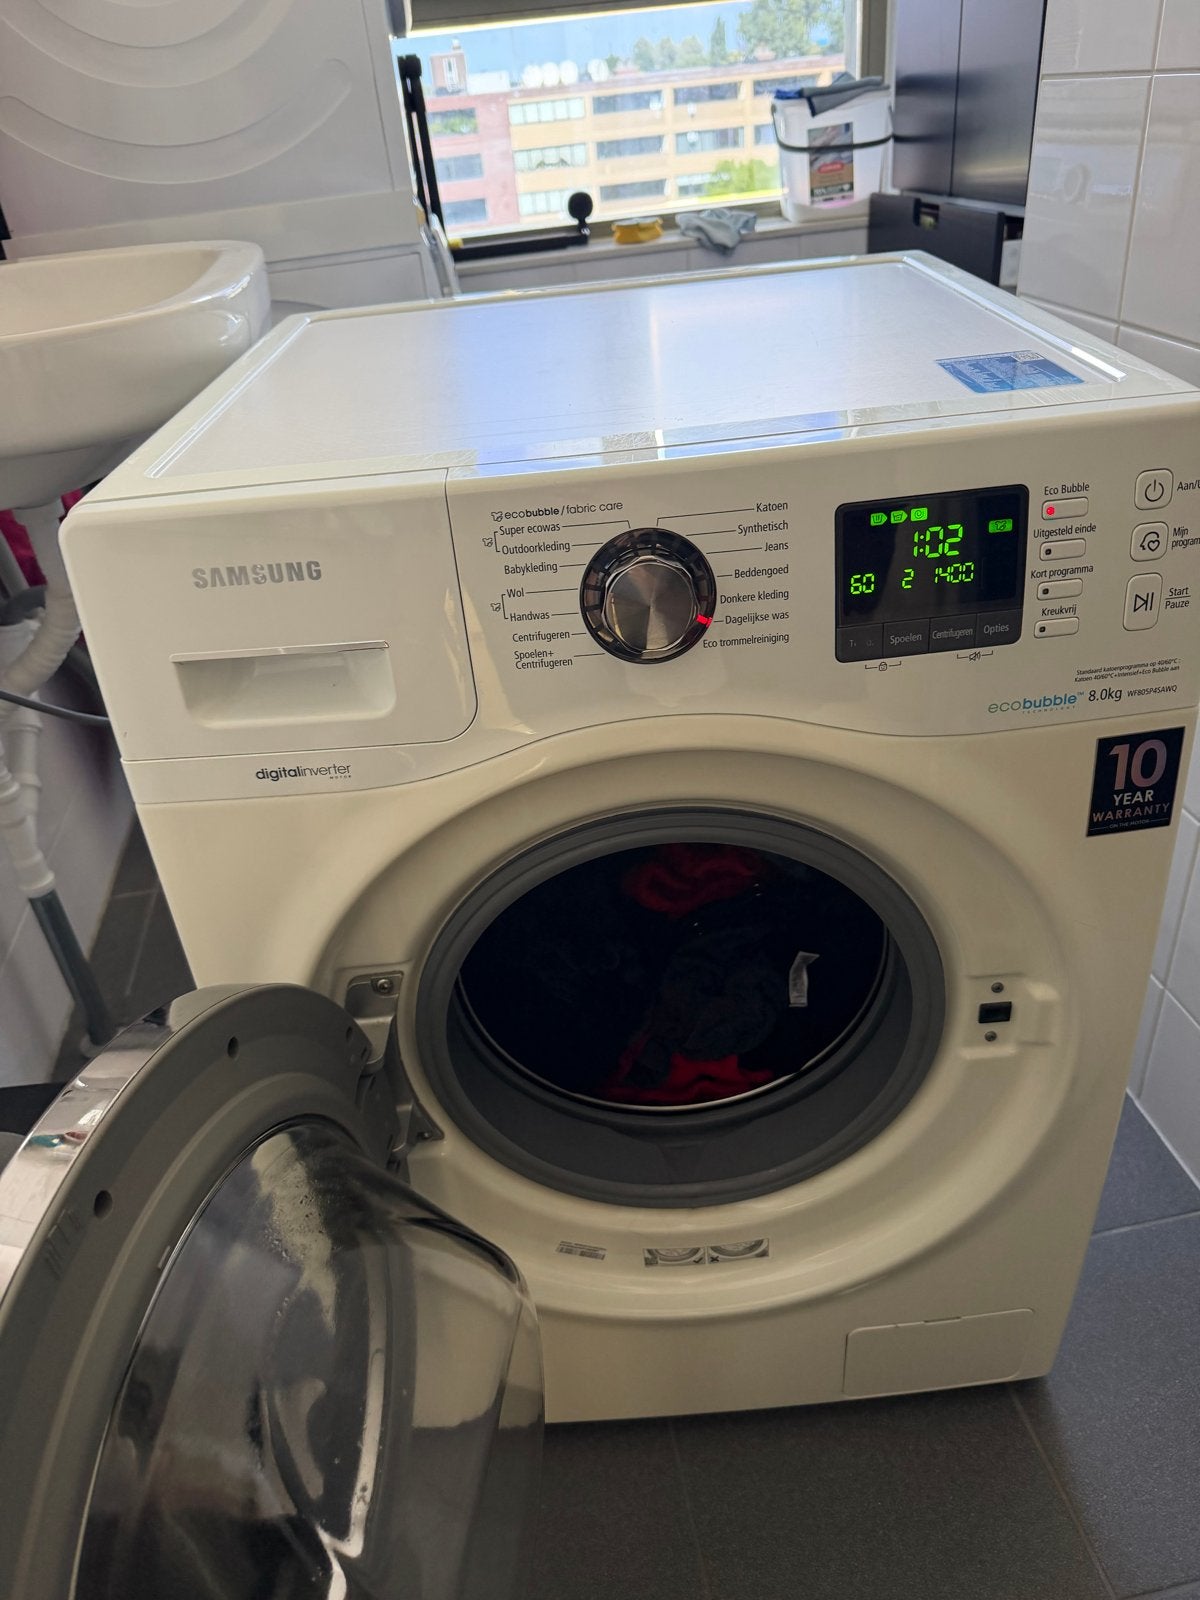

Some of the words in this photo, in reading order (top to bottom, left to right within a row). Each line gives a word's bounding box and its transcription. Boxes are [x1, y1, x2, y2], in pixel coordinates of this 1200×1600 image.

[1044, 486, 1059, 496] Eco
[1061, 482, 1090, 494] Bubble
[599, 501, 623, 512] care
[756, 502, 788, 513] Katoen
[499, 525, 524, 537] Super
[528, 522, 561, 534] ecowas
[738, 520, 789, 536] Synthetisch
[1033, 525, 1073, 539] Uitgesteld
[1074, 523, 1097, 533] einde
[1173, 525, 1189, 538] Mijn
[502, 541, 571, 555] Outdoorkleding
[764, 542, 789, 552] Jeans
[913, 524, 963, 558] 1:02
[192, 560, 322, 589] SAMSUNG
[504, 562, 558, 576] Babykleding
[734, 564, 789, 579] Beddengoed
[1030, 569, 1047, 579] Kort
[1048, 565, 1094, 578] programma
[850, 573, 875, 595] 60
[902, 568, 915, 589] 2
[935, 562, 974, 583] 1400
[507, 587, 524, 598] Wol
[720, 593, 756, 604] Donkere
[758, 590, 789, 601] kleding
[1169, 586, 1189, 597] Start
[1041, 604, 1077, 617] Kreukvrij
[1165, 600, 1190, 610] Pauze
[510, 611, 550, 622] Handwas
[725, 613, 770, 626] Dagelijkse
[772, 610, 790, 620] was
[512, 630, 570, 642] Centrifugeren
[703, 639, 718, 649] Eco
[720, 632, 790, 647] trommelreiniging
[889, 631, 922, 645] Spoelen
[932, 627, 974, 640] Centrifugeren
[983, 623, 1010, 635] Opties
[514, 649, 554, 661] Spoelen+
[515, 658, 573, 670] Centrifugeren
[1088, 687, 1123, 702] 8.0kg
[1108, 739, 1167, 790] 10
[255, 763, 351, 782] digitalinverter
[1113, 789, 1154, 806] YEAR
[1092, 802, 1170, 823] WARRANTY
